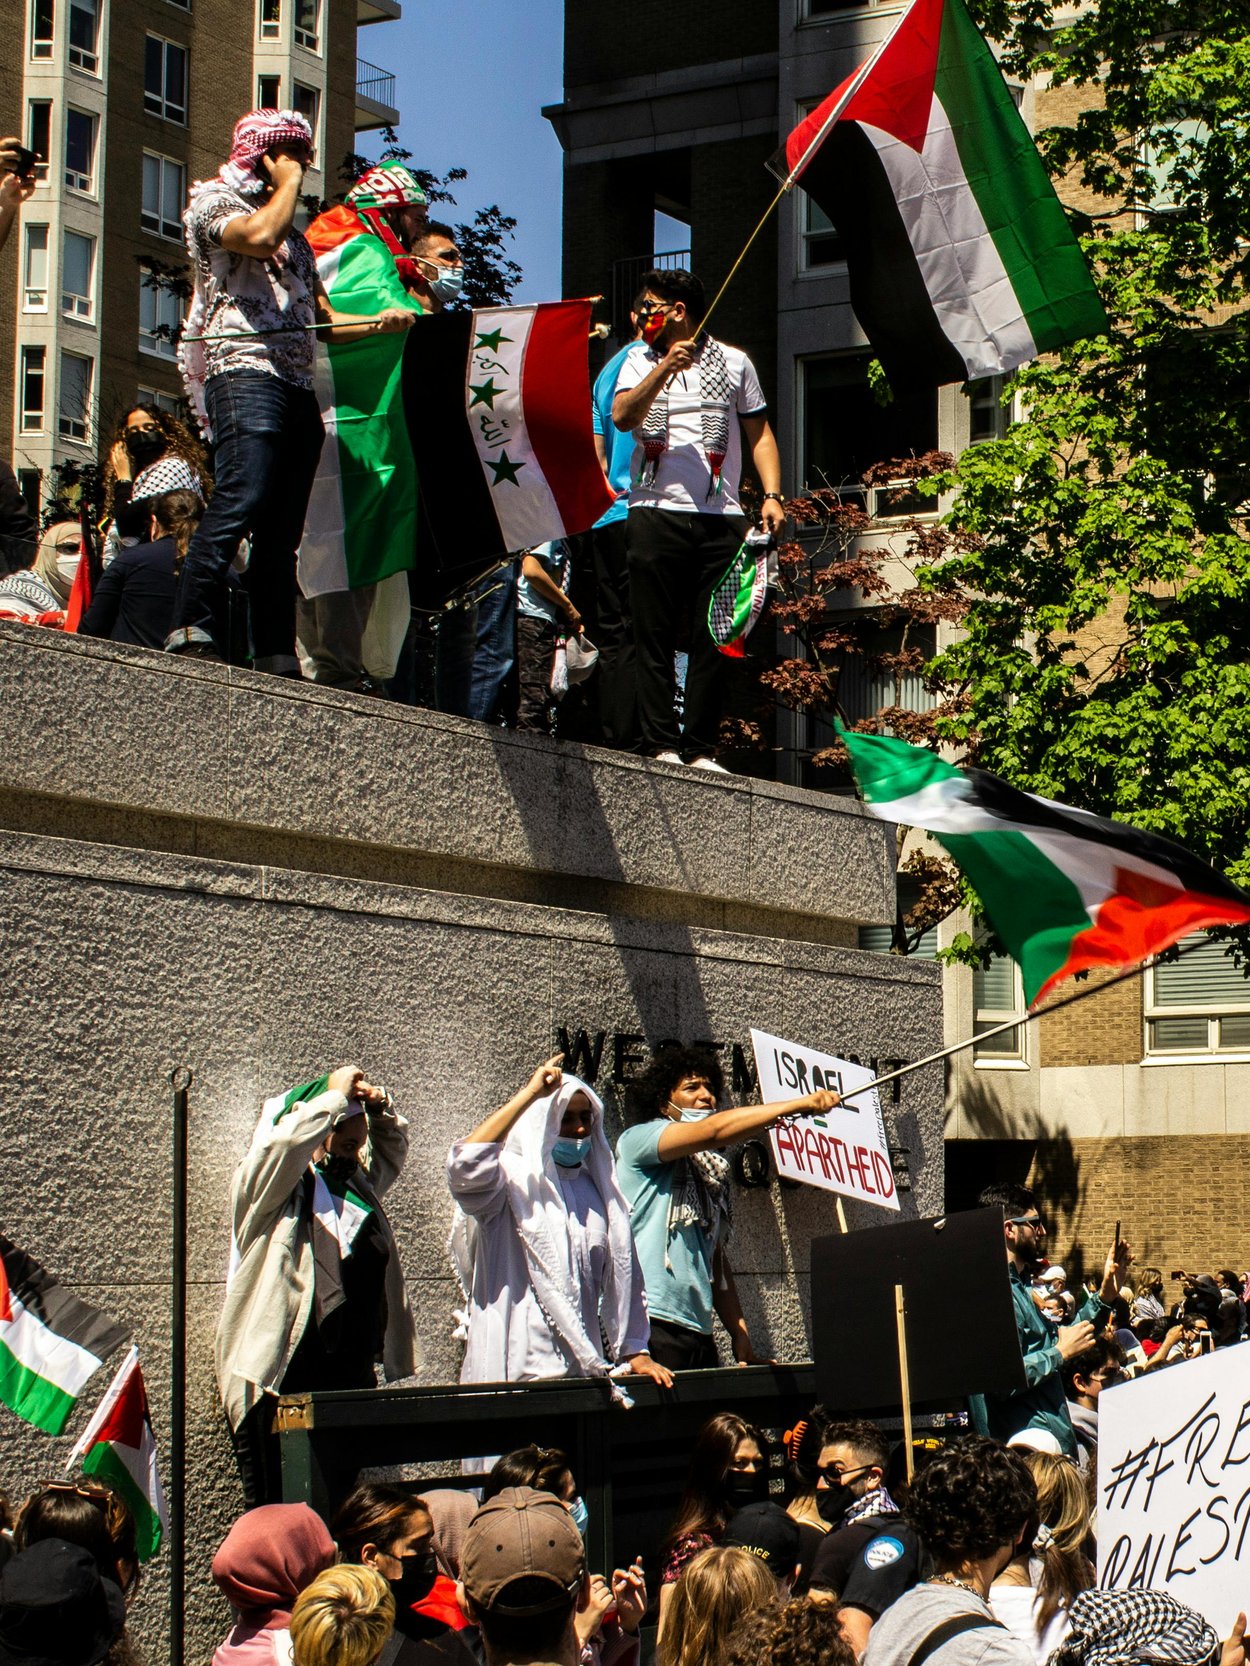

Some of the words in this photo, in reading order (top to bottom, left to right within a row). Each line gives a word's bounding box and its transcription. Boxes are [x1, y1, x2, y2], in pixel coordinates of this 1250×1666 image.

[774, 1048, 860, 1114] ISRAEL
[775, 1118, 894, 1198] APARTHEID
[740, 1545, 770, 1560] OLICE
